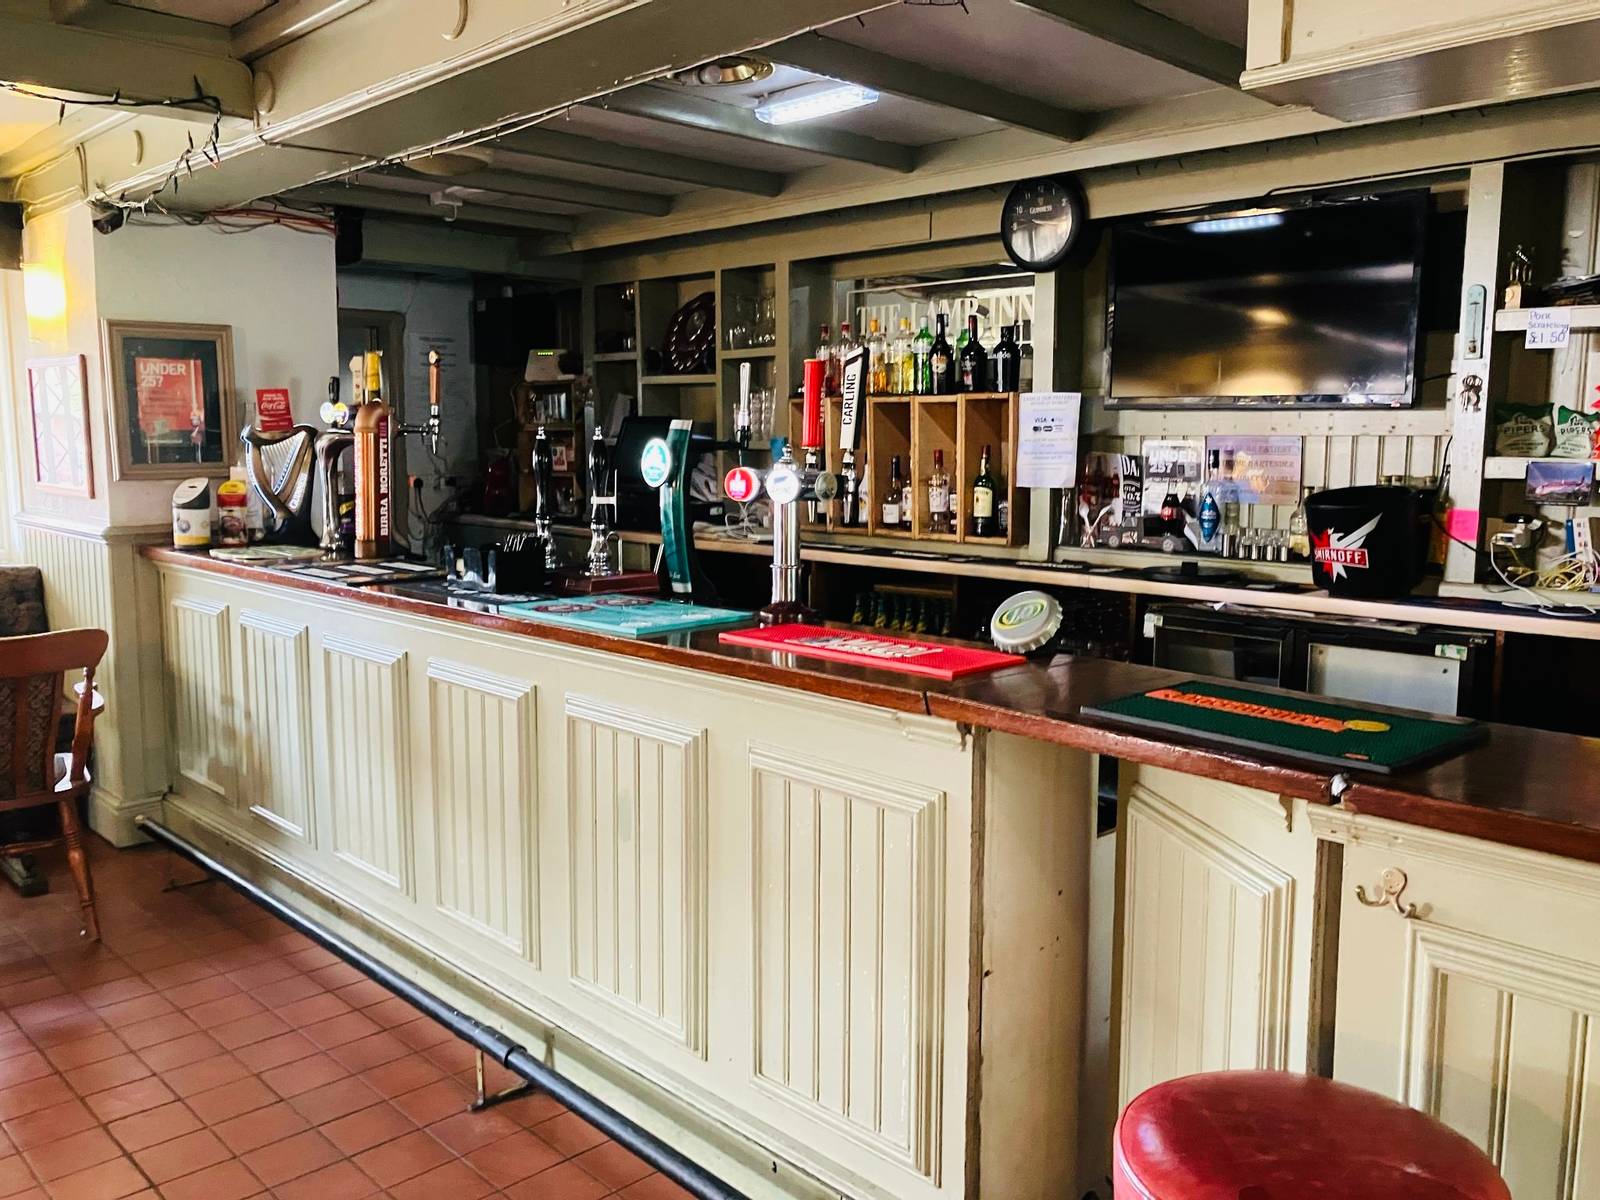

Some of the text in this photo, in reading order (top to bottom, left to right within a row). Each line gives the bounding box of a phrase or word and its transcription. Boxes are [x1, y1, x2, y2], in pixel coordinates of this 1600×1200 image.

[1016, 206, 1024, 215] 10
[1029, 205, 1053, 214] GUINNESS
[989, 294, 1035, 328] INN
[140, 362, 187, 376] UNDER
[140, 375, 164, 388] 25?
[842, 373, 858, 425] CARLING
[1034, 416, 1048, 424] VISA
[1503, 424, 1545, 435] PIPERS
[1560, 427, 1592, 437] PIPERS
[1149, 445, 1198, 462] UNDER
[379, 437, 388, 494] MORETTI
[380, 497, 389, 537] BIRRA
[1315, 549, 1362, 564] SMIRNOFF
